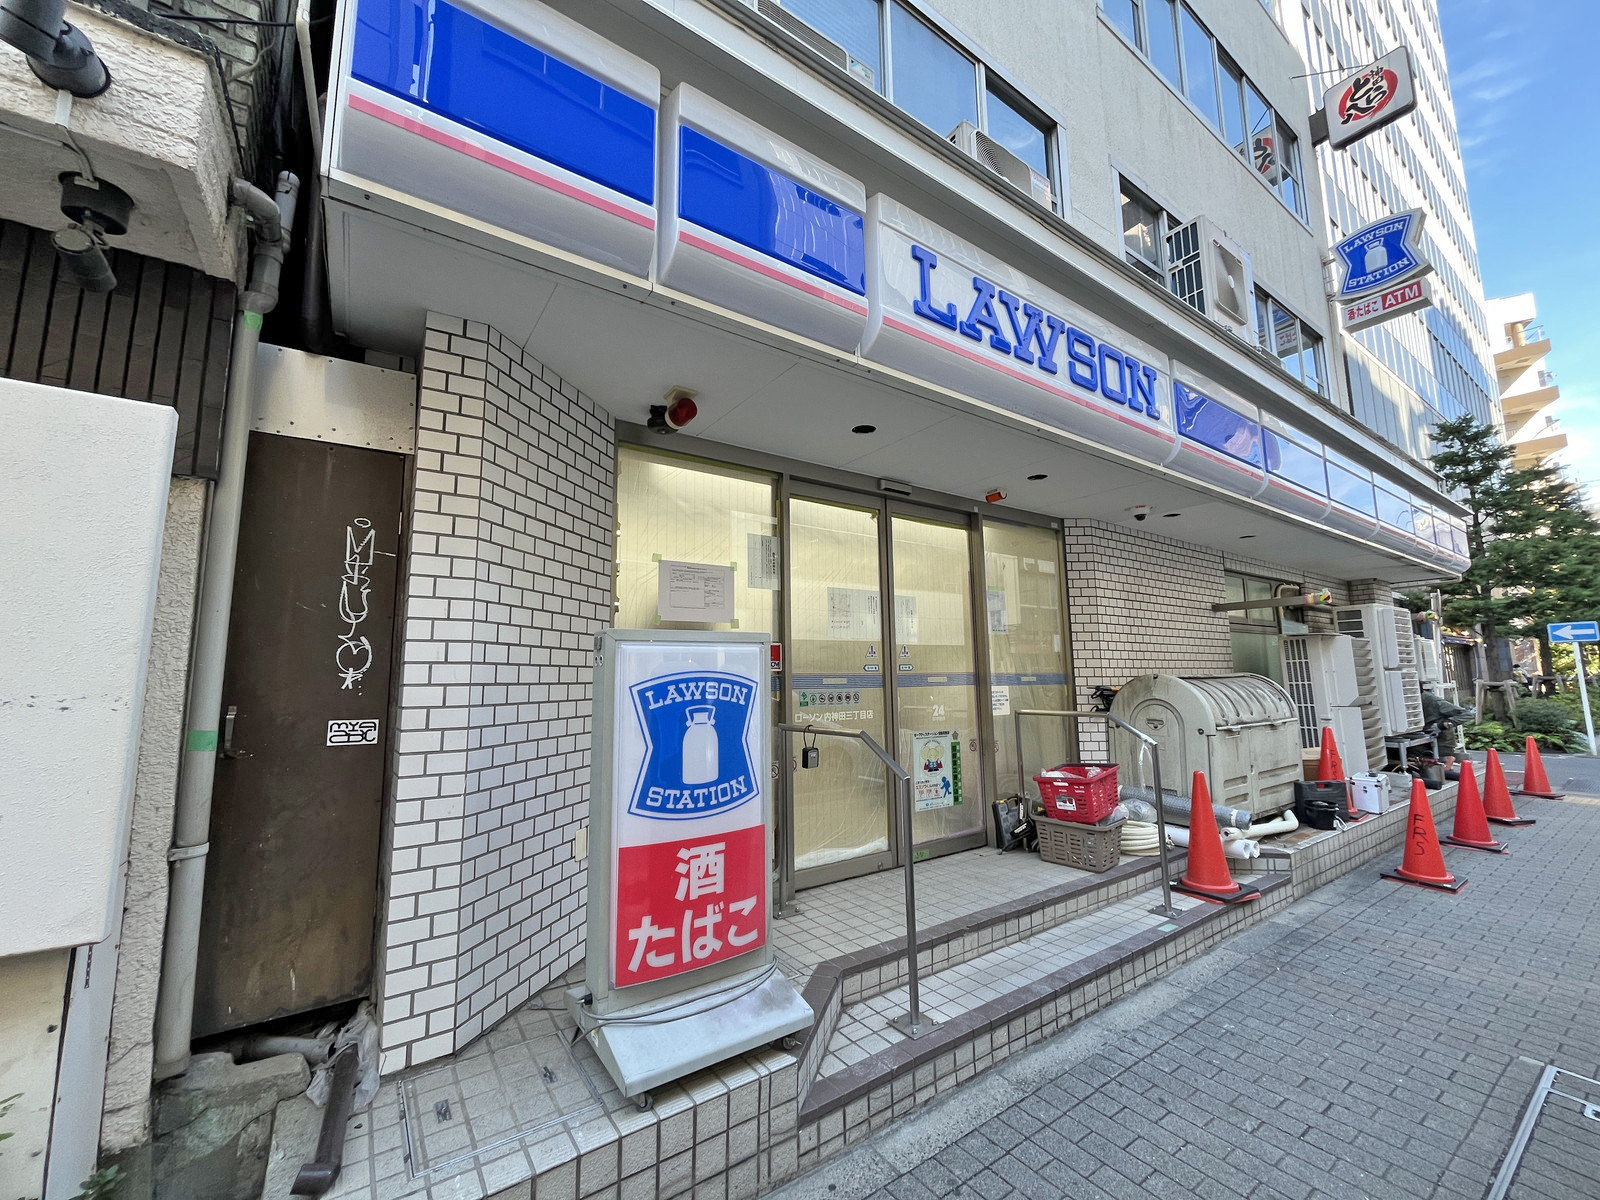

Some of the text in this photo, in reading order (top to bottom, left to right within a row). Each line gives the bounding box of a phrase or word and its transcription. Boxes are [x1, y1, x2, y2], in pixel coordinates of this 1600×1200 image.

[1343, 221, 1406, 254] LAWSON
[1347, 256, 1410, 288] STATION
[1384, 284, 1419, 308] ATM
[911, 244, 1160, 421] LAWSON
[645, 679, 749, 710] LAWSON
[645, 775, 749, 811] STATION
[1413, 814, 1429, 856] FRS
[674, 841, 727, 902] 酒
[627, 895, 759, 973] たばこ
